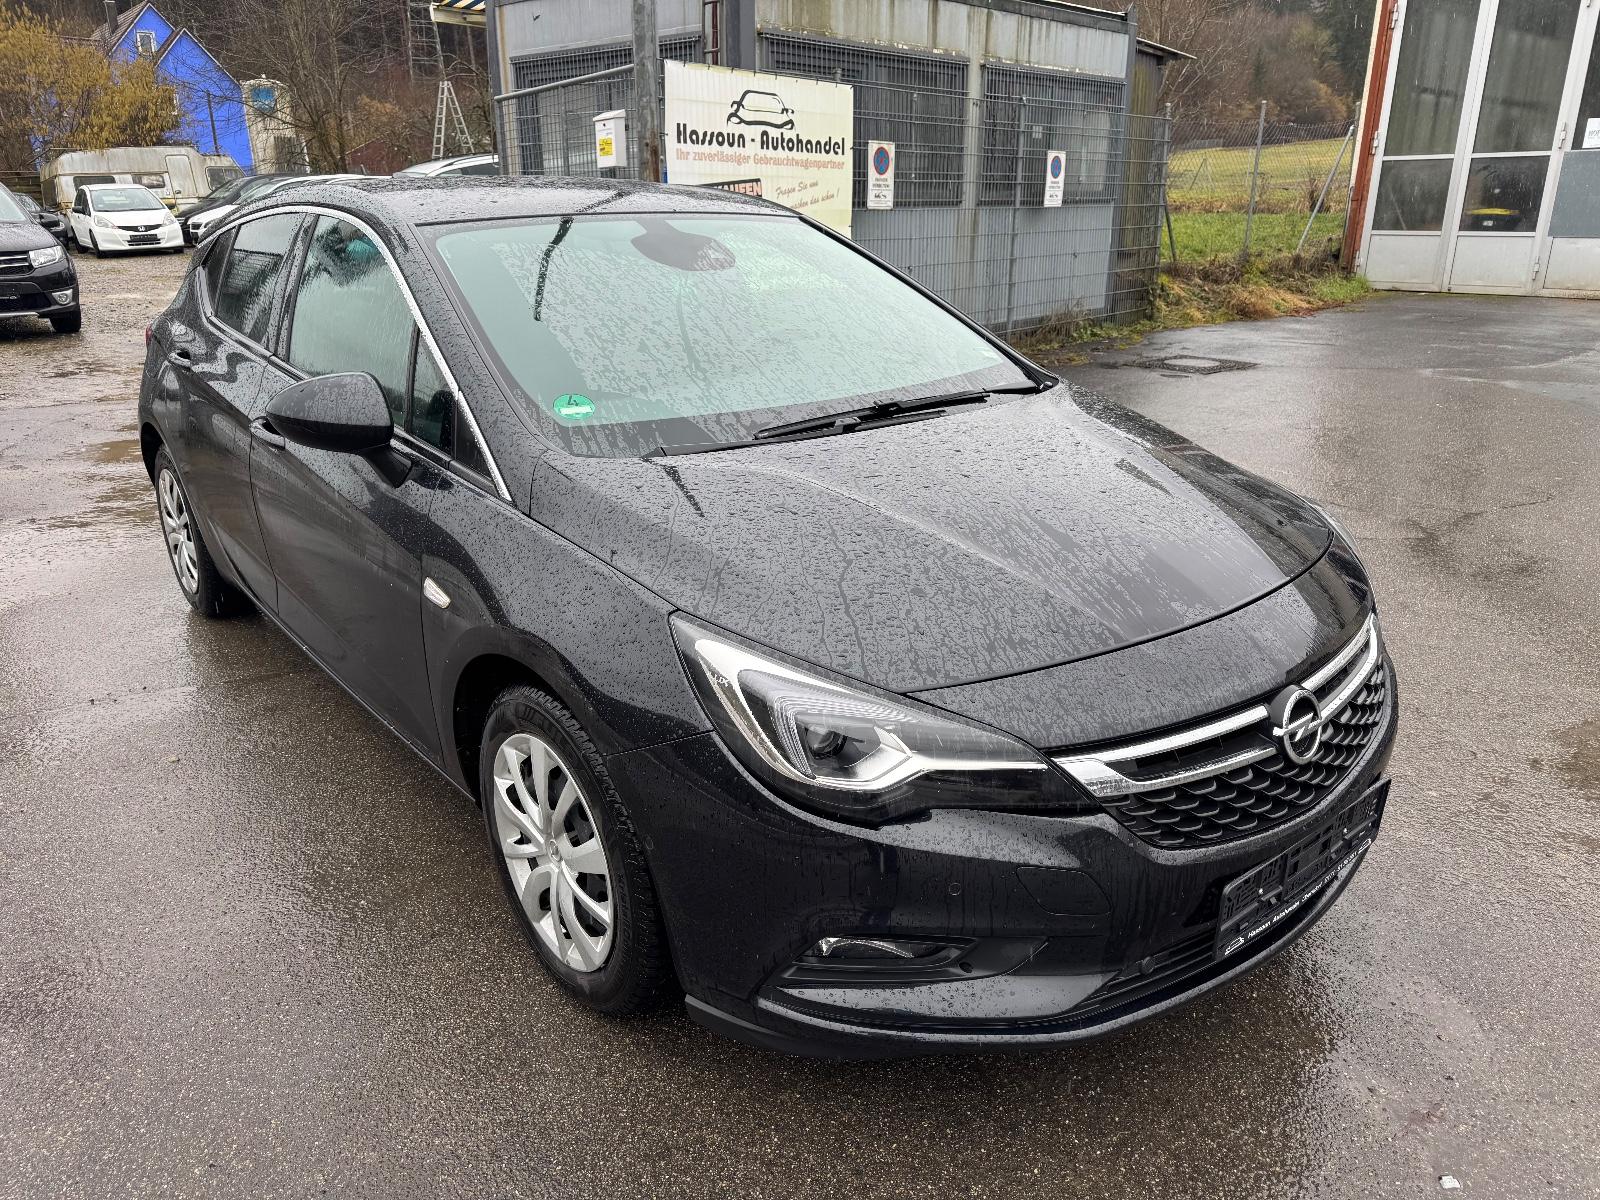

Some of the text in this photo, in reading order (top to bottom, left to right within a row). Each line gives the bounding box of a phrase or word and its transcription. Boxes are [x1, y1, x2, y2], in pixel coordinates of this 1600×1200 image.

[676, 122, 746, 148] Hassoun
[760, 130, 845, 155] Autohandel
[676, 148, 845, 170] Ihr zuverlässiger Gebrauchtwagenpartner
[714, 181, 762, 196] AUFEN
